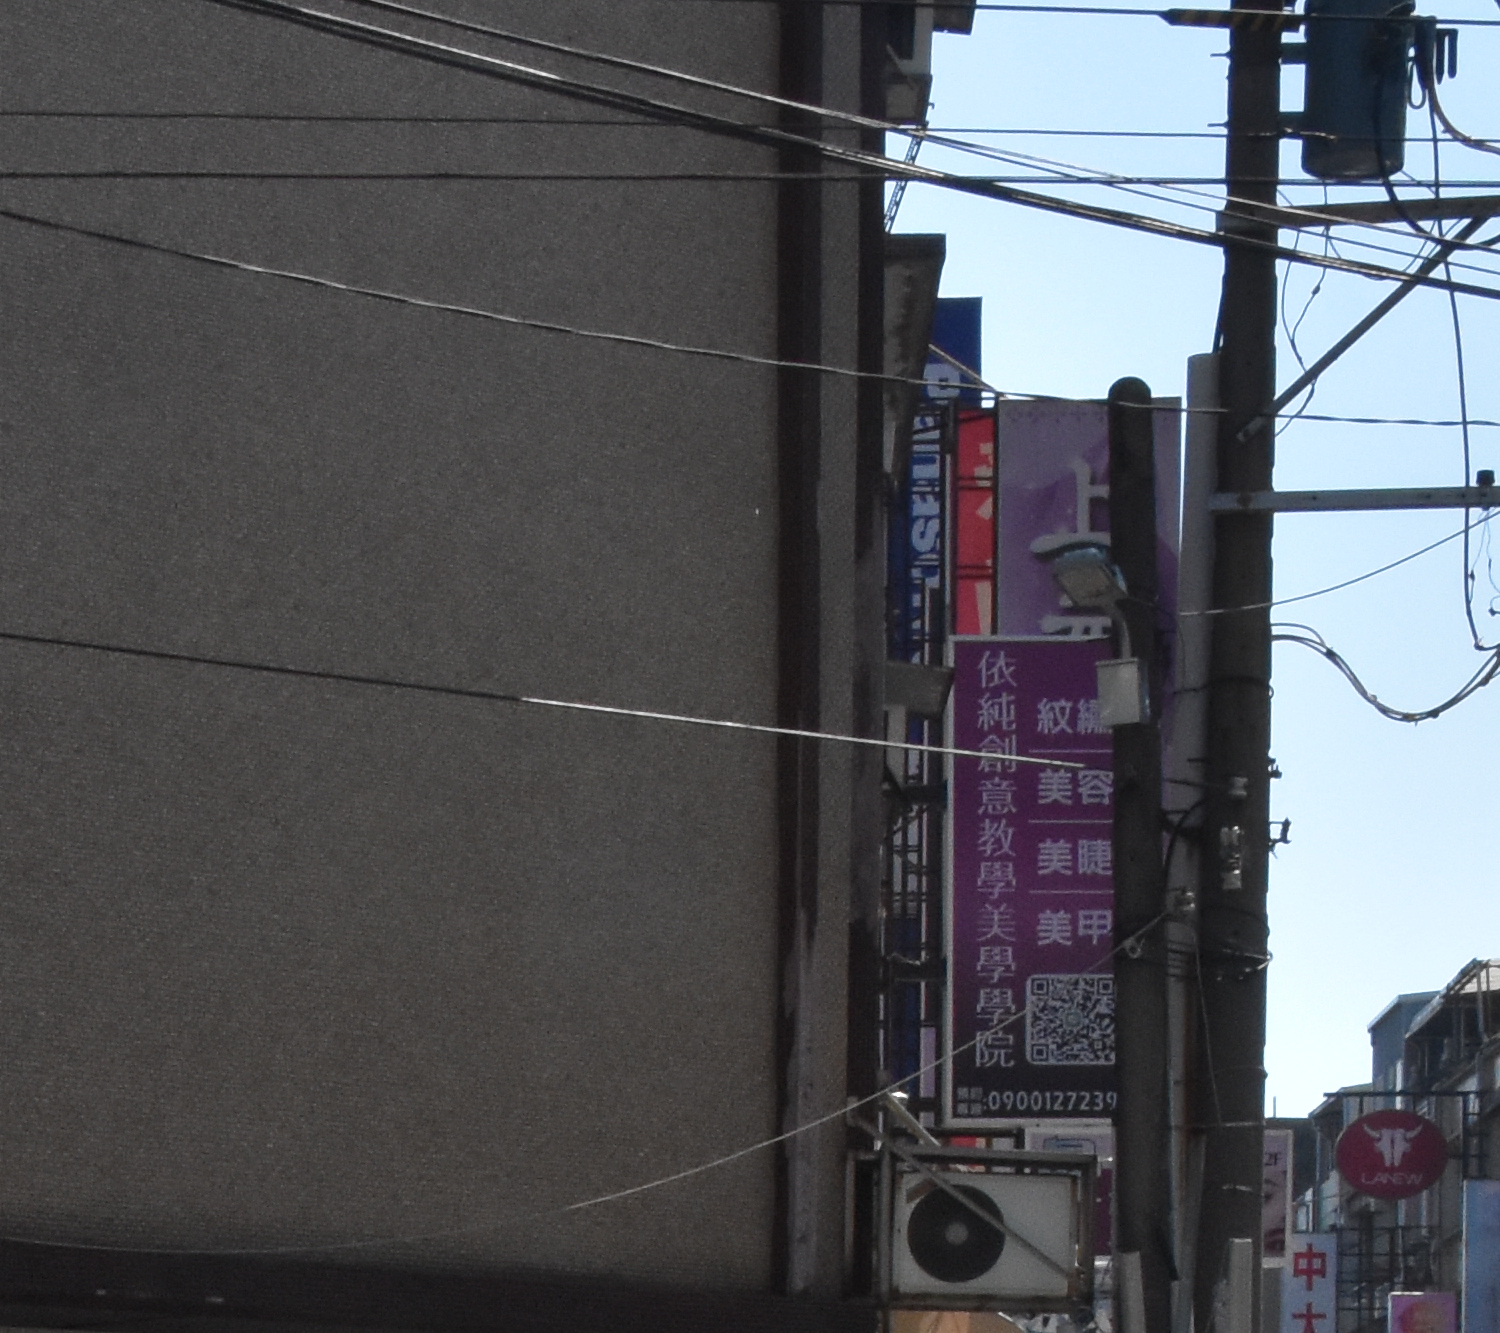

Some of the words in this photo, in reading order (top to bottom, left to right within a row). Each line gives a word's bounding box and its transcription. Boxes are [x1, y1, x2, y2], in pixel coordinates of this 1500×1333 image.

[1036, 768, 1113, 806] 美容
[976, 650, 1018, 1068] 依純創意教學美學學院
[1036, 838, 1113, 876] 美睫
[1036, 909, 1113, 946] 美甲
